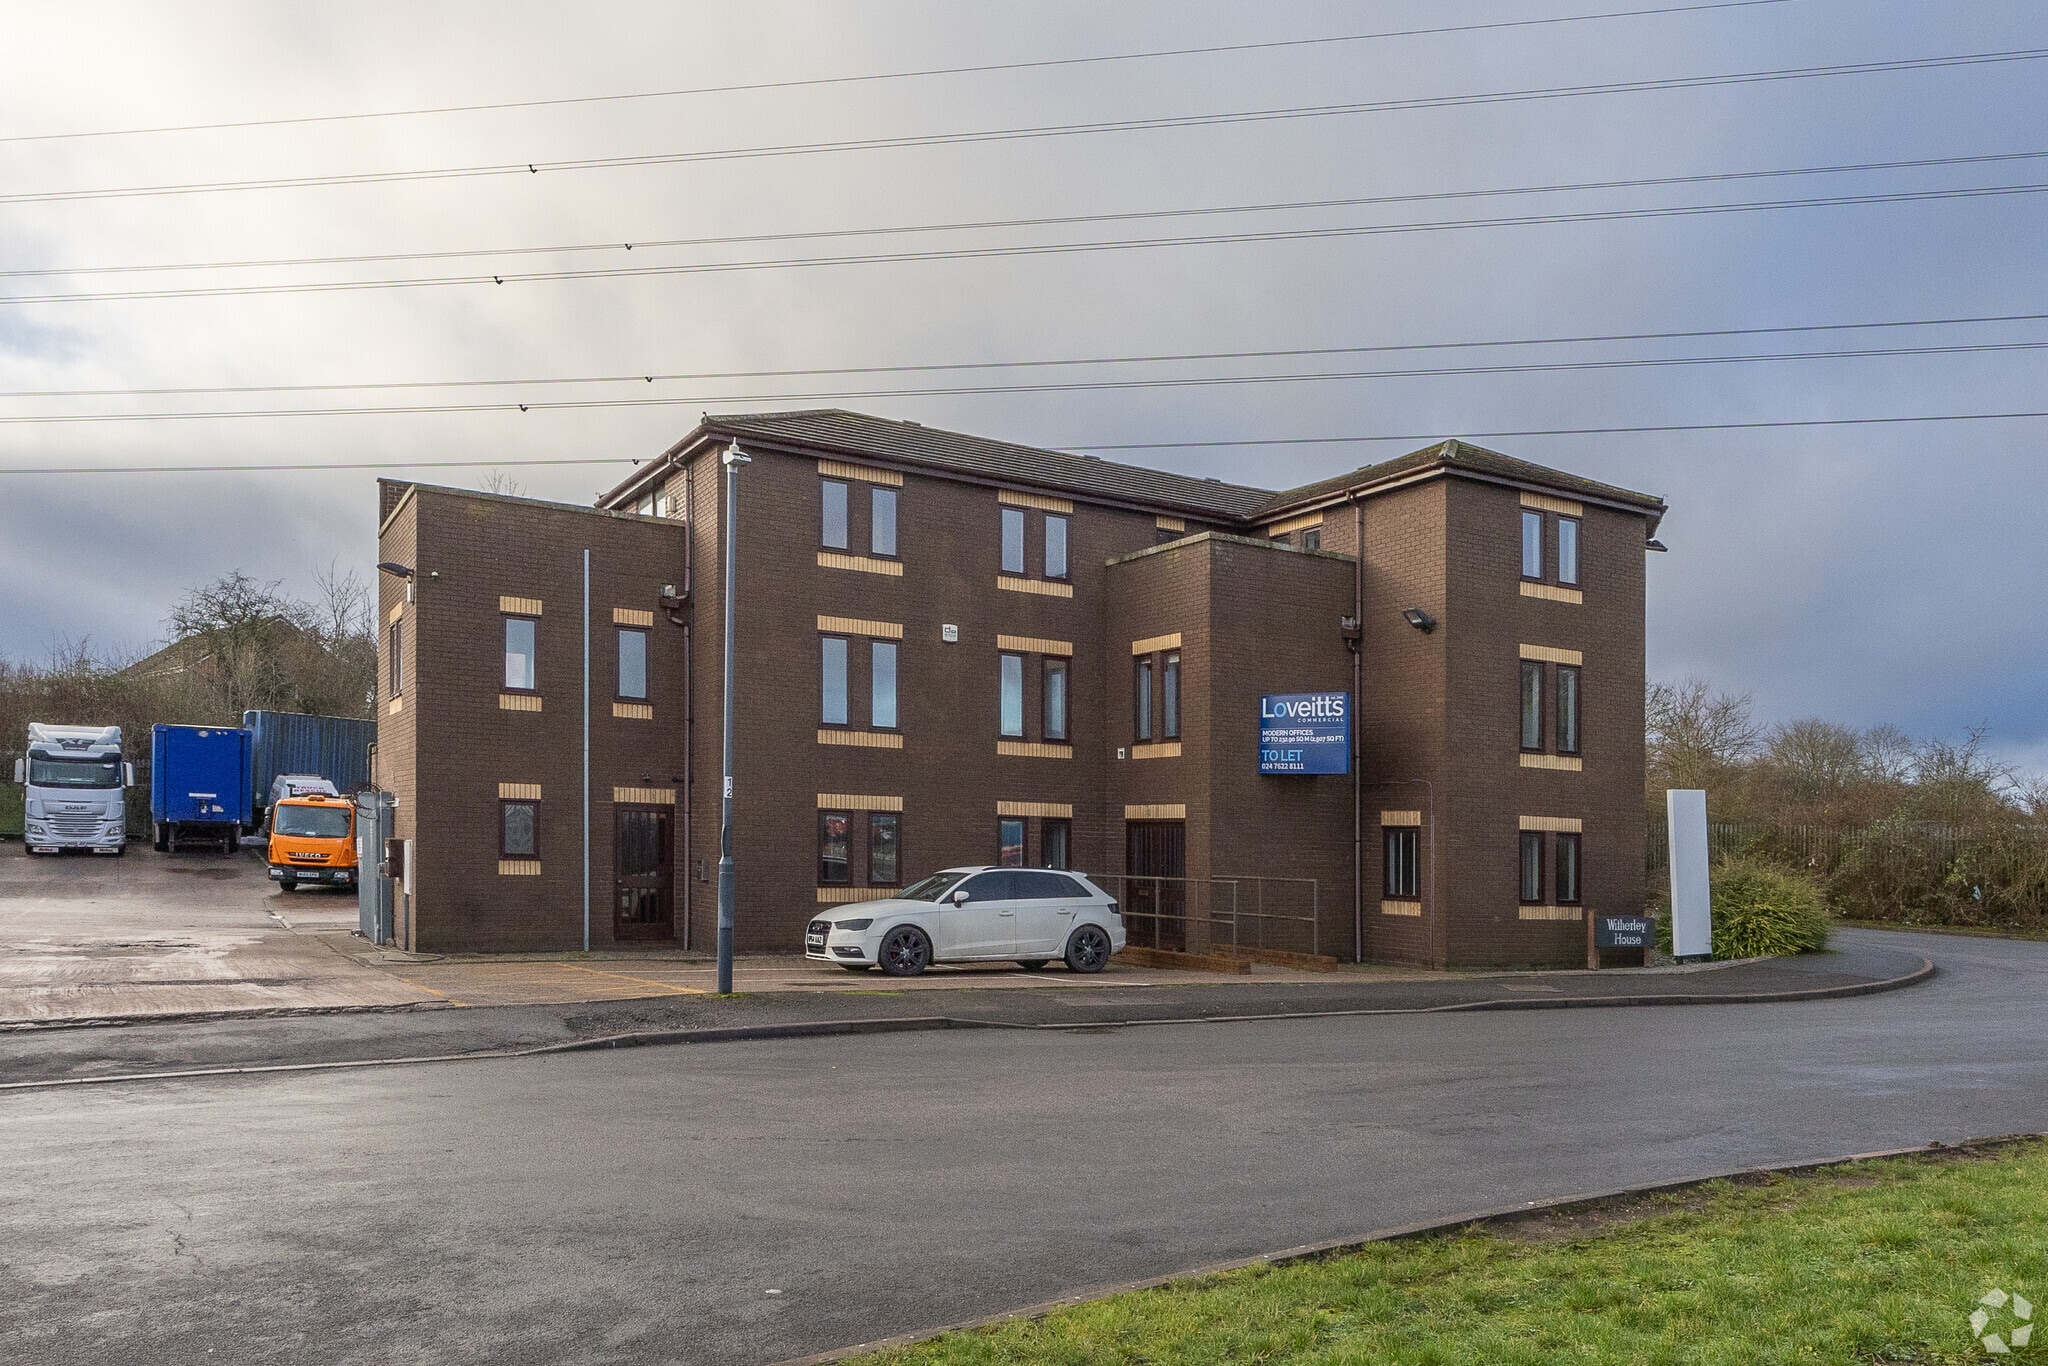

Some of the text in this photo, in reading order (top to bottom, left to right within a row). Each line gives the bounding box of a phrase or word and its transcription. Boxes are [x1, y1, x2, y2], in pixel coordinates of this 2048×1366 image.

[1262, 696, 1344, 718] Loveitts
[1262, 750, 1303, 761] TO LET
[1606, 918, 1646, 933] Witherley
[1614, 933, 1642, 945] House
